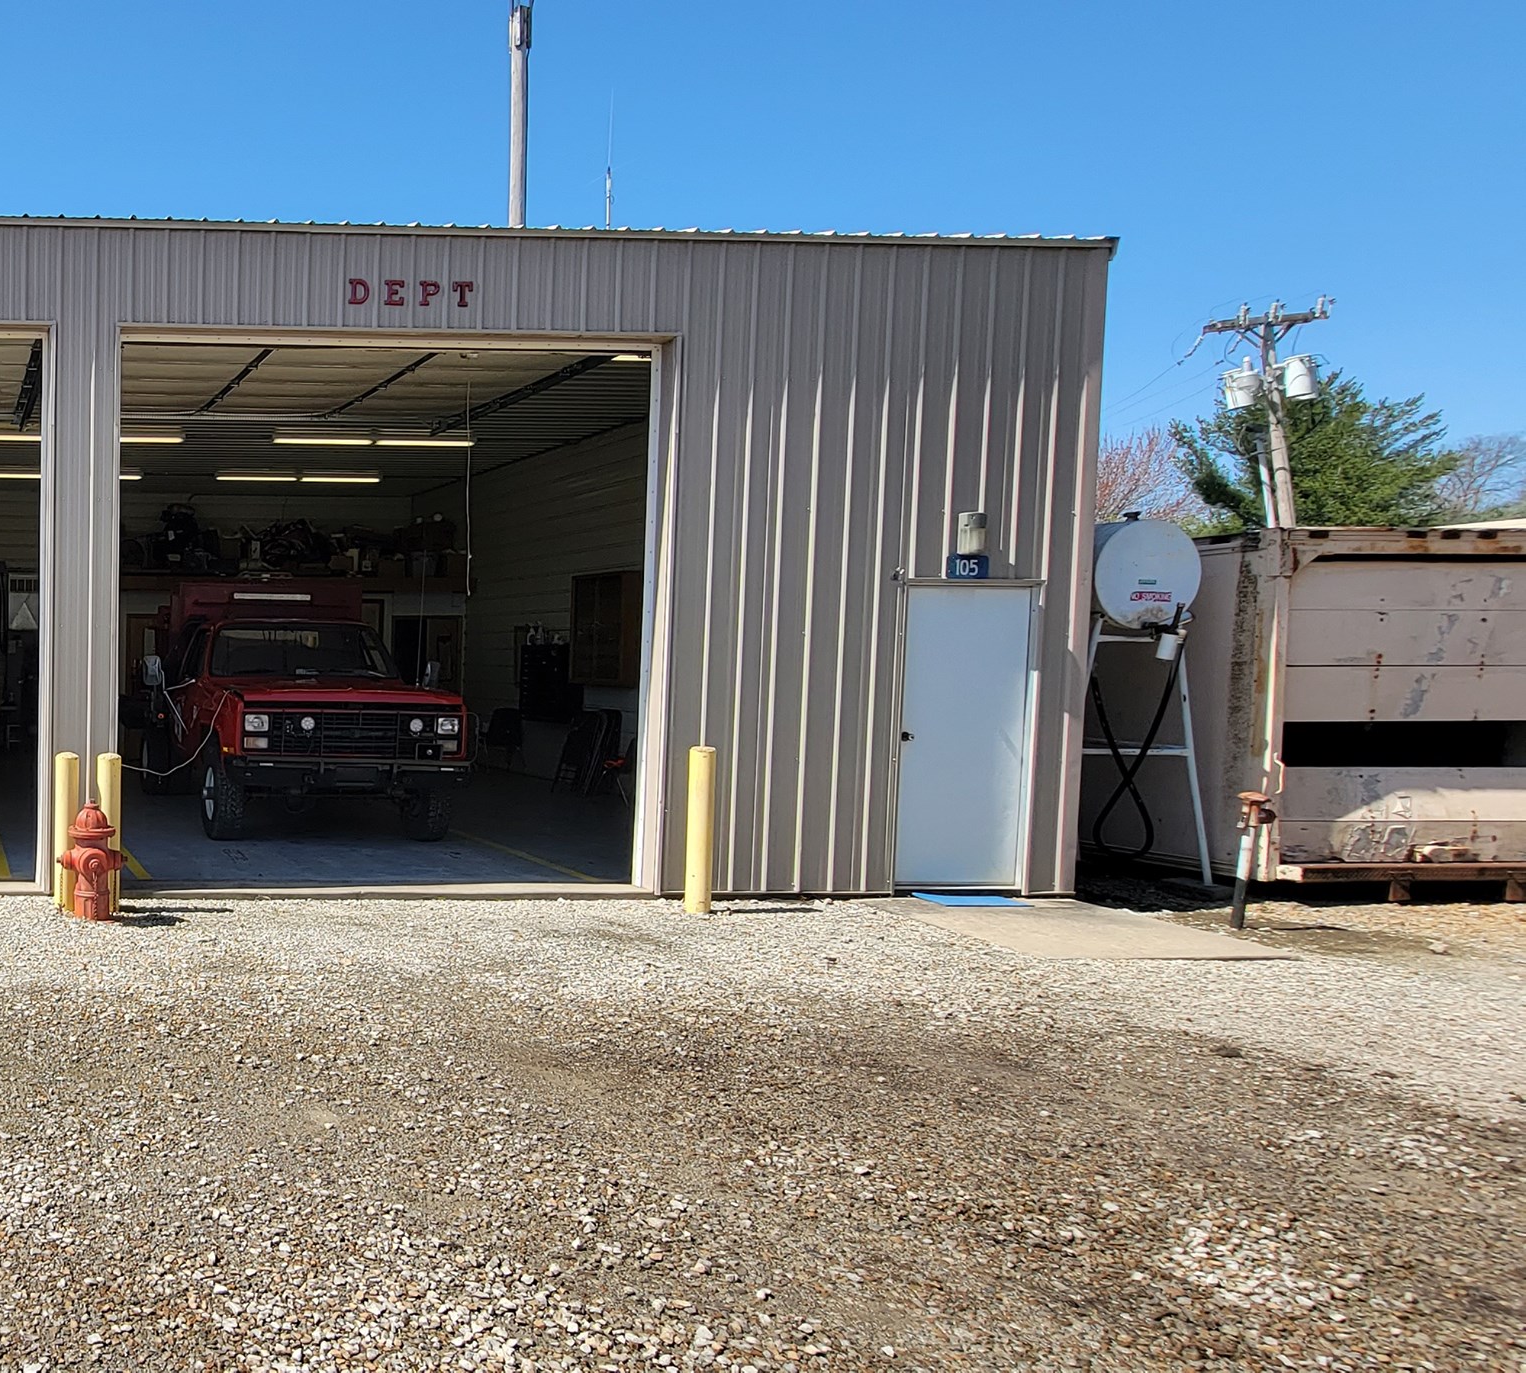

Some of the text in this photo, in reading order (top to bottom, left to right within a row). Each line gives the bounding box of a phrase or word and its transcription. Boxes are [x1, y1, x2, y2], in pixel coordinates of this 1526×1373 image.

[347, 278, 474, 307] DEPT
[955, 558, 979, 576] 105
[1130, 592, 1141, 601] NO
